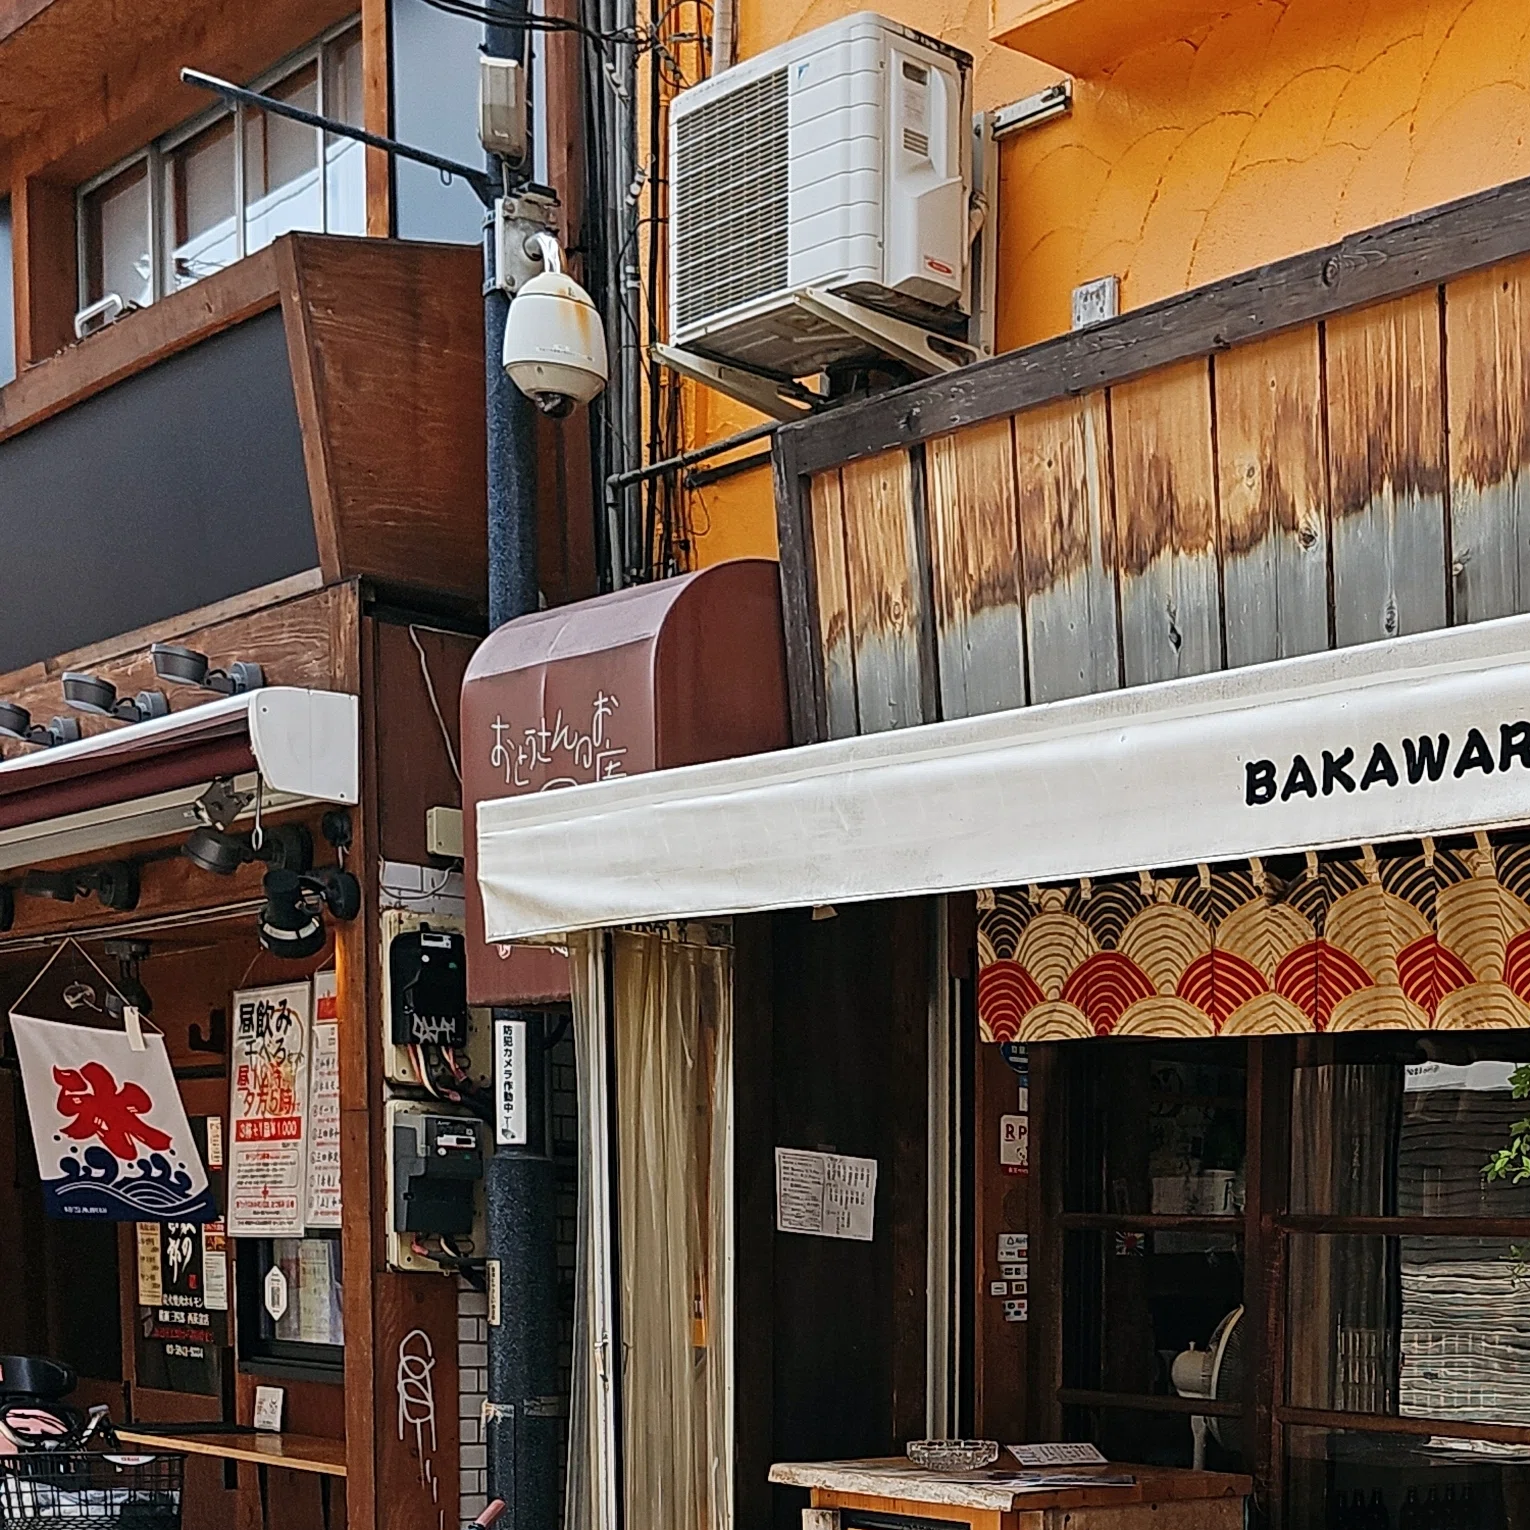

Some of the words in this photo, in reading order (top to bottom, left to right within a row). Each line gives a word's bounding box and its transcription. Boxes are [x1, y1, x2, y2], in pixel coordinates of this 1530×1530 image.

[238, 998, 292, 1039] 昼飲み
[52, 1062, 173, 1160] 氷
